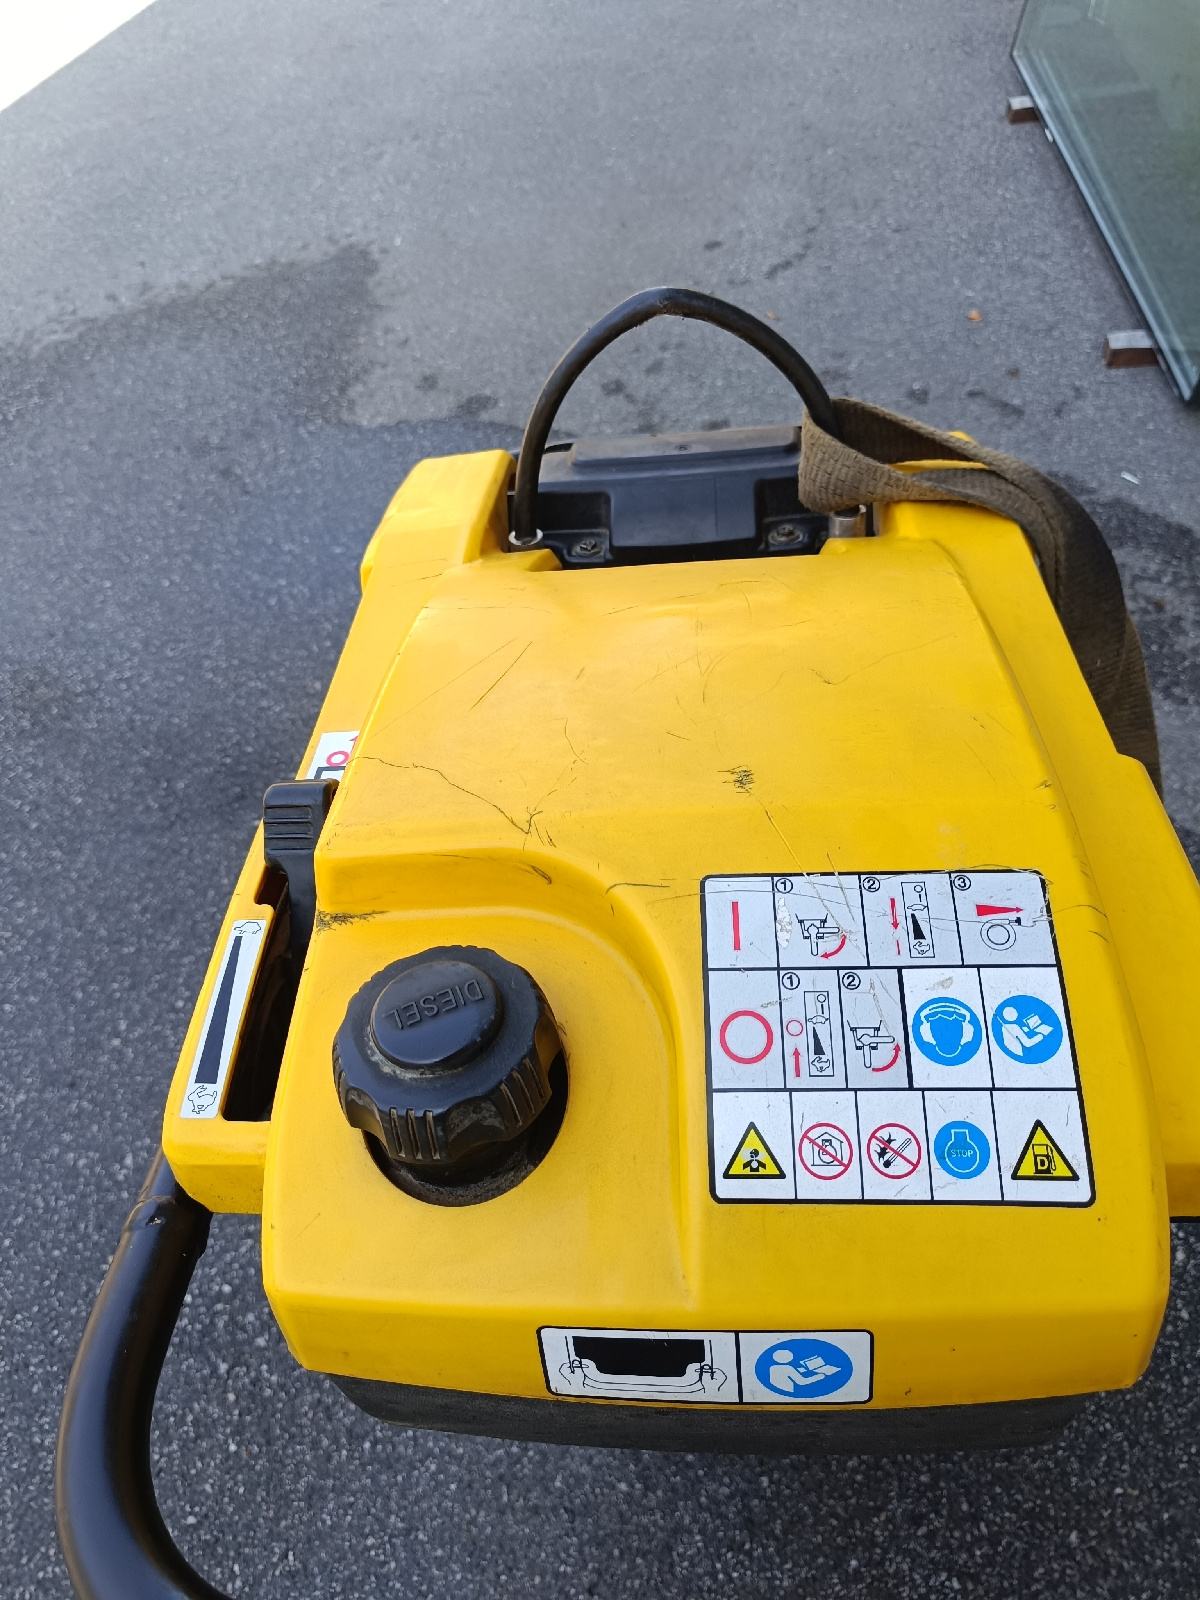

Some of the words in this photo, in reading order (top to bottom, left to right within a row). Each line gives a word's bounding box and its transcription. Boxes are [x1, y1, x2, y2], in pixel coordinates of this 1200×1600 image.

[382, 979, 484, 1030] DIESEL
[950, 1149, 974, 1158] STOP
[1036, 1156, 1049, 1170] D
